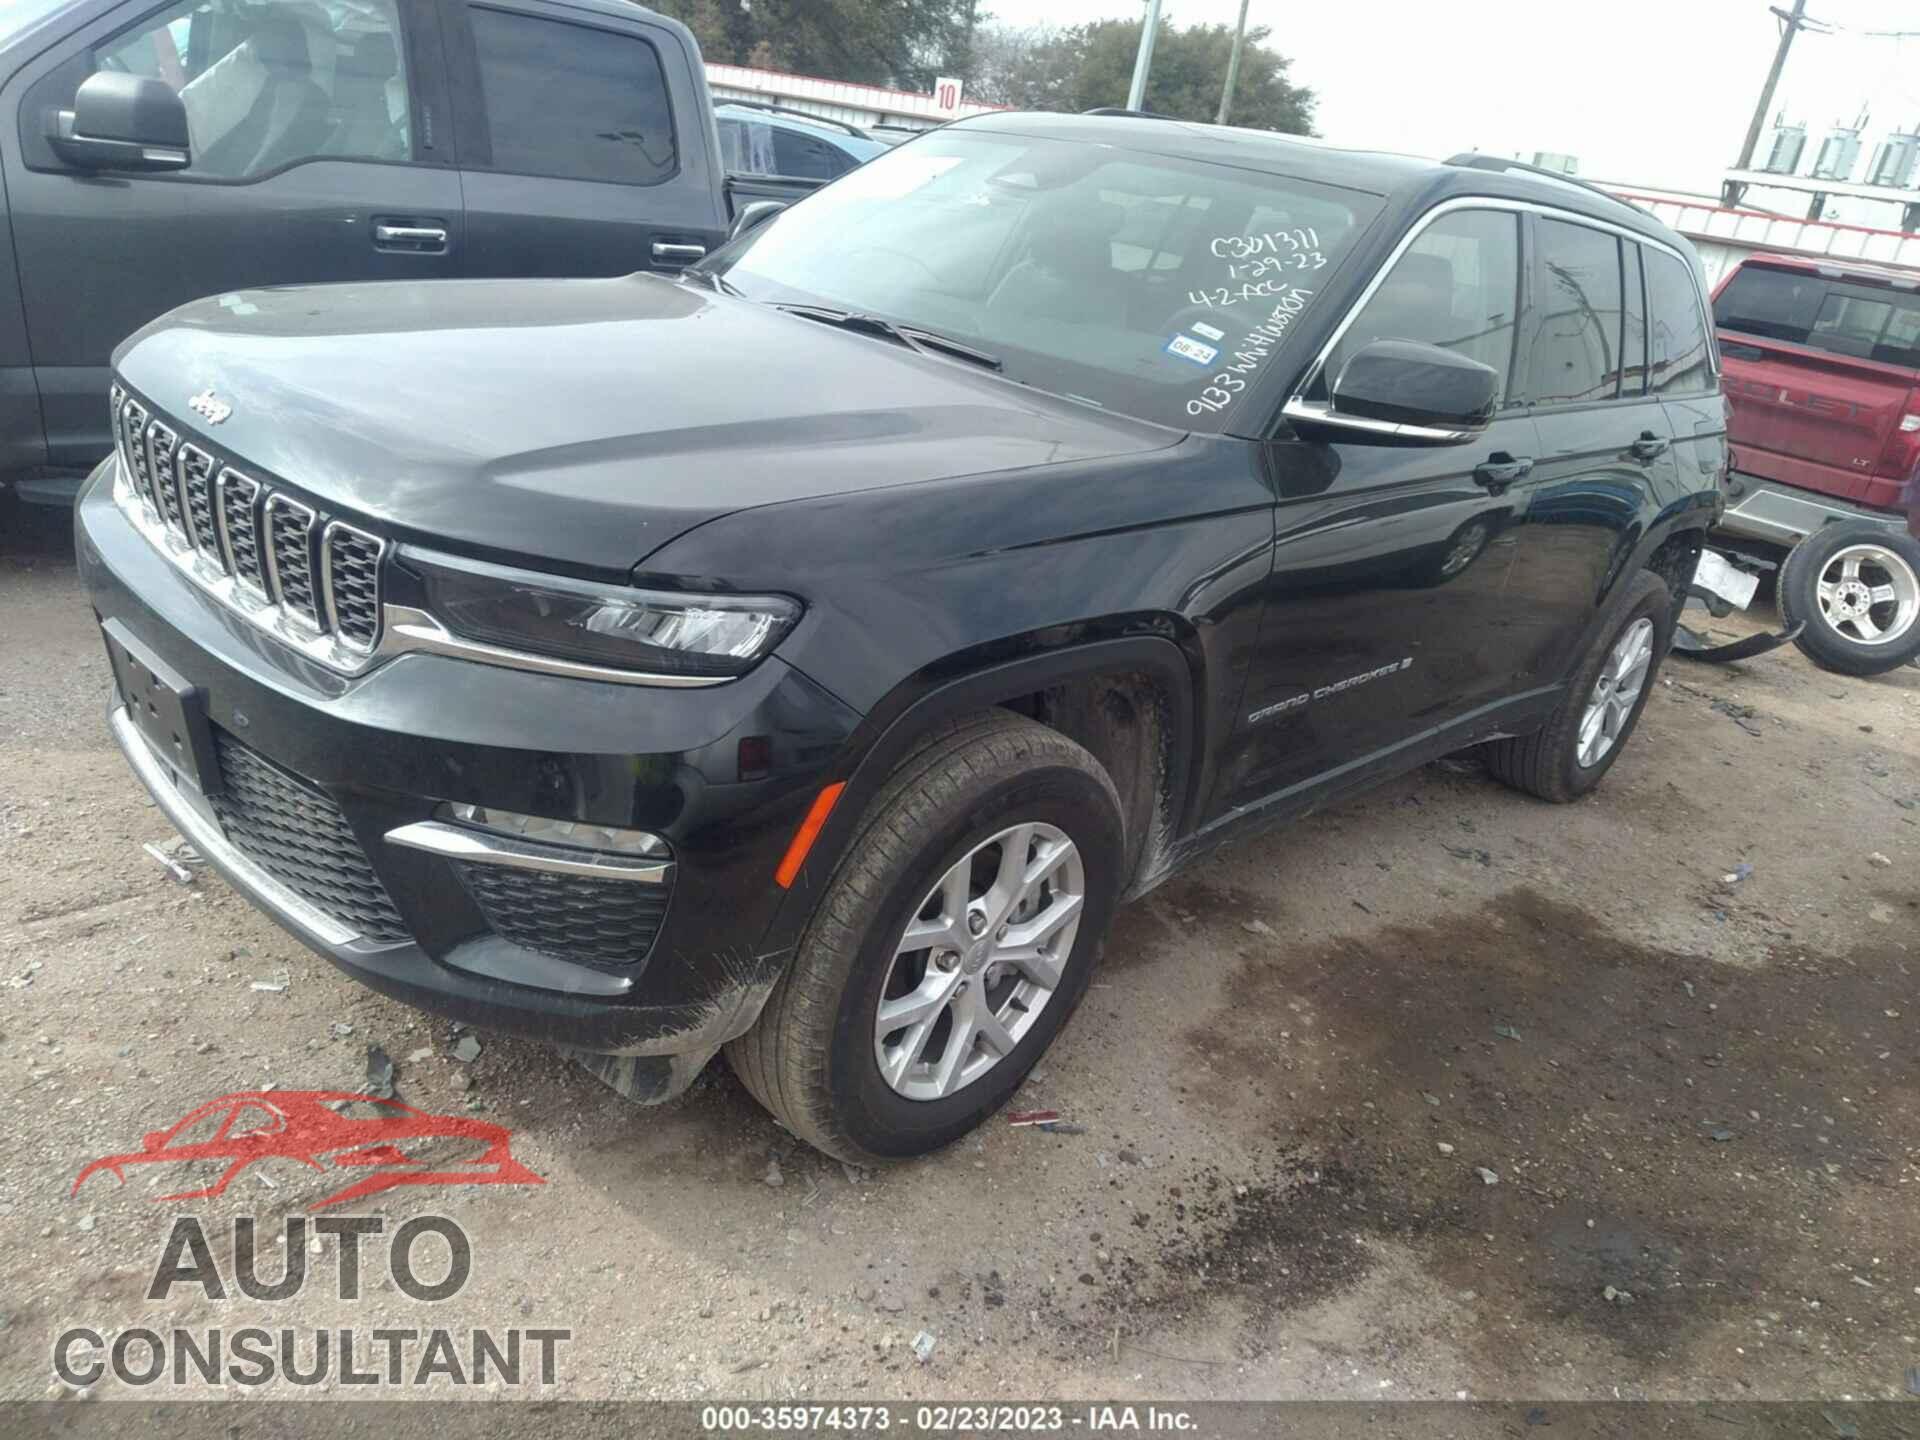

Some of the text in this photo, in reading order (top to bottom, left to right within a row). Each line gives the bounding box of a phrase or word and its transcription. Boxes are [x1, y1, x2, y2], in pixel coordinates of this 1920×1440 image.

[939, 84, 955, 111] 10
[188, 388, 233, 425] Jeep
[1187, 374, 1245, 414] 9133
[1853, 456, 1871, 468] LT
[1248, 662, 1400, 722] GRAND CHEROKEE
